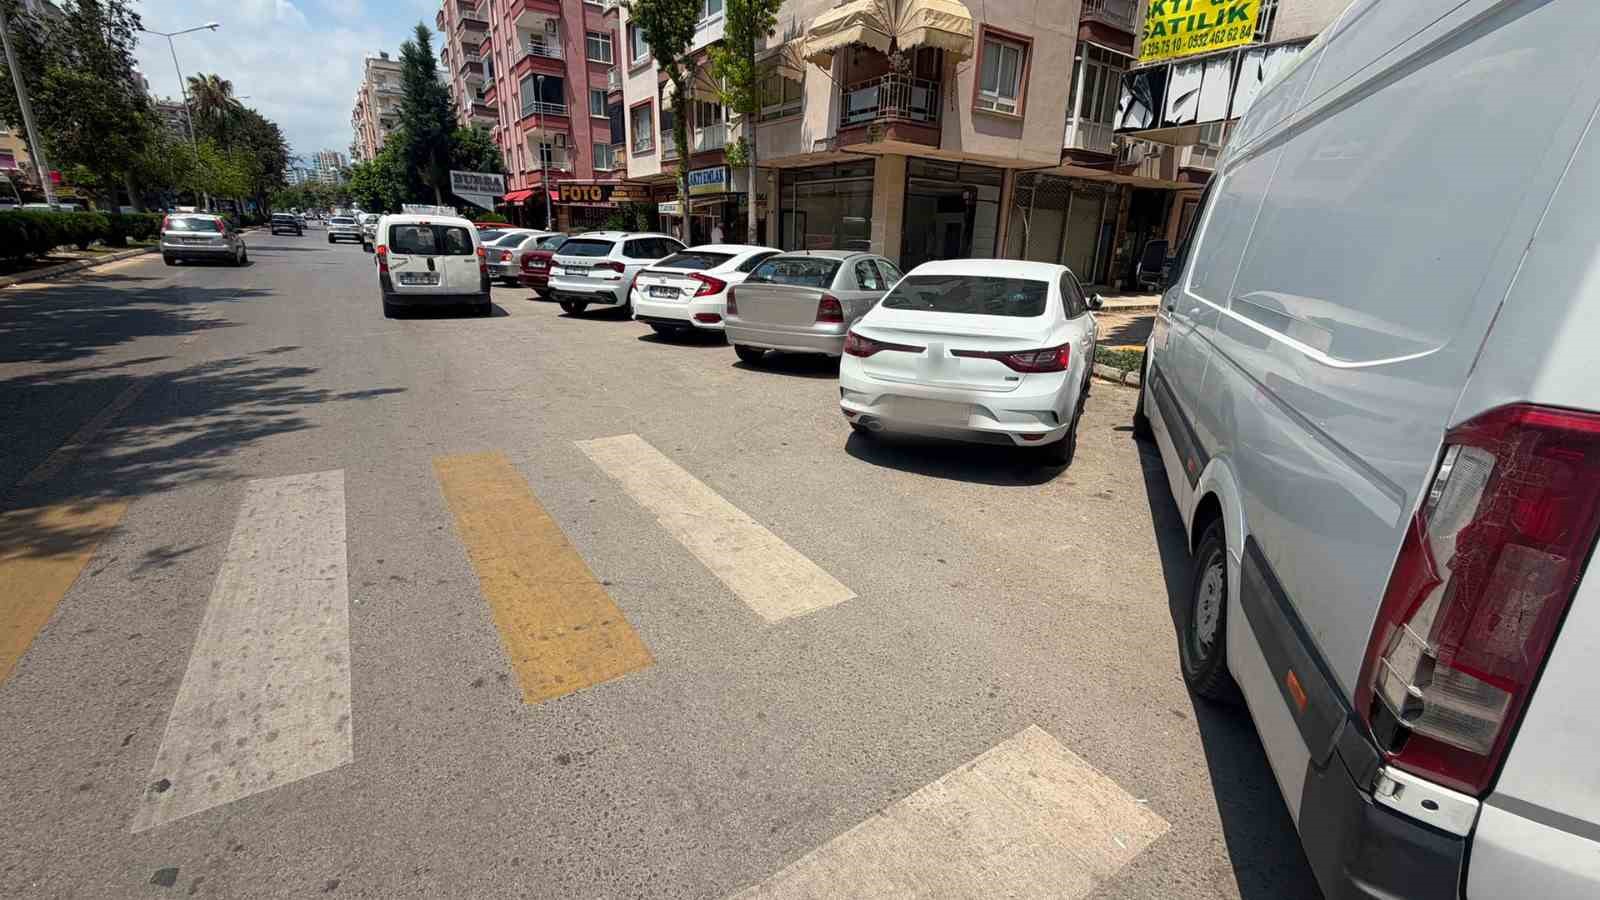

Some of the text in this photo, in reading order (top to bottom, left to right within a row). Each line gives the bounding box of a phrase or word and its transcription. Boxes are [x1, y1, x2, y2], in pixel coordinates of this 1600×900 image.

[1145, 0, 1193, 19] KTI
[1173, 37, 1182, 51] 10
[1188, 32, 1209, 48] 0532
[560, 185, 602, 201] FOTO
